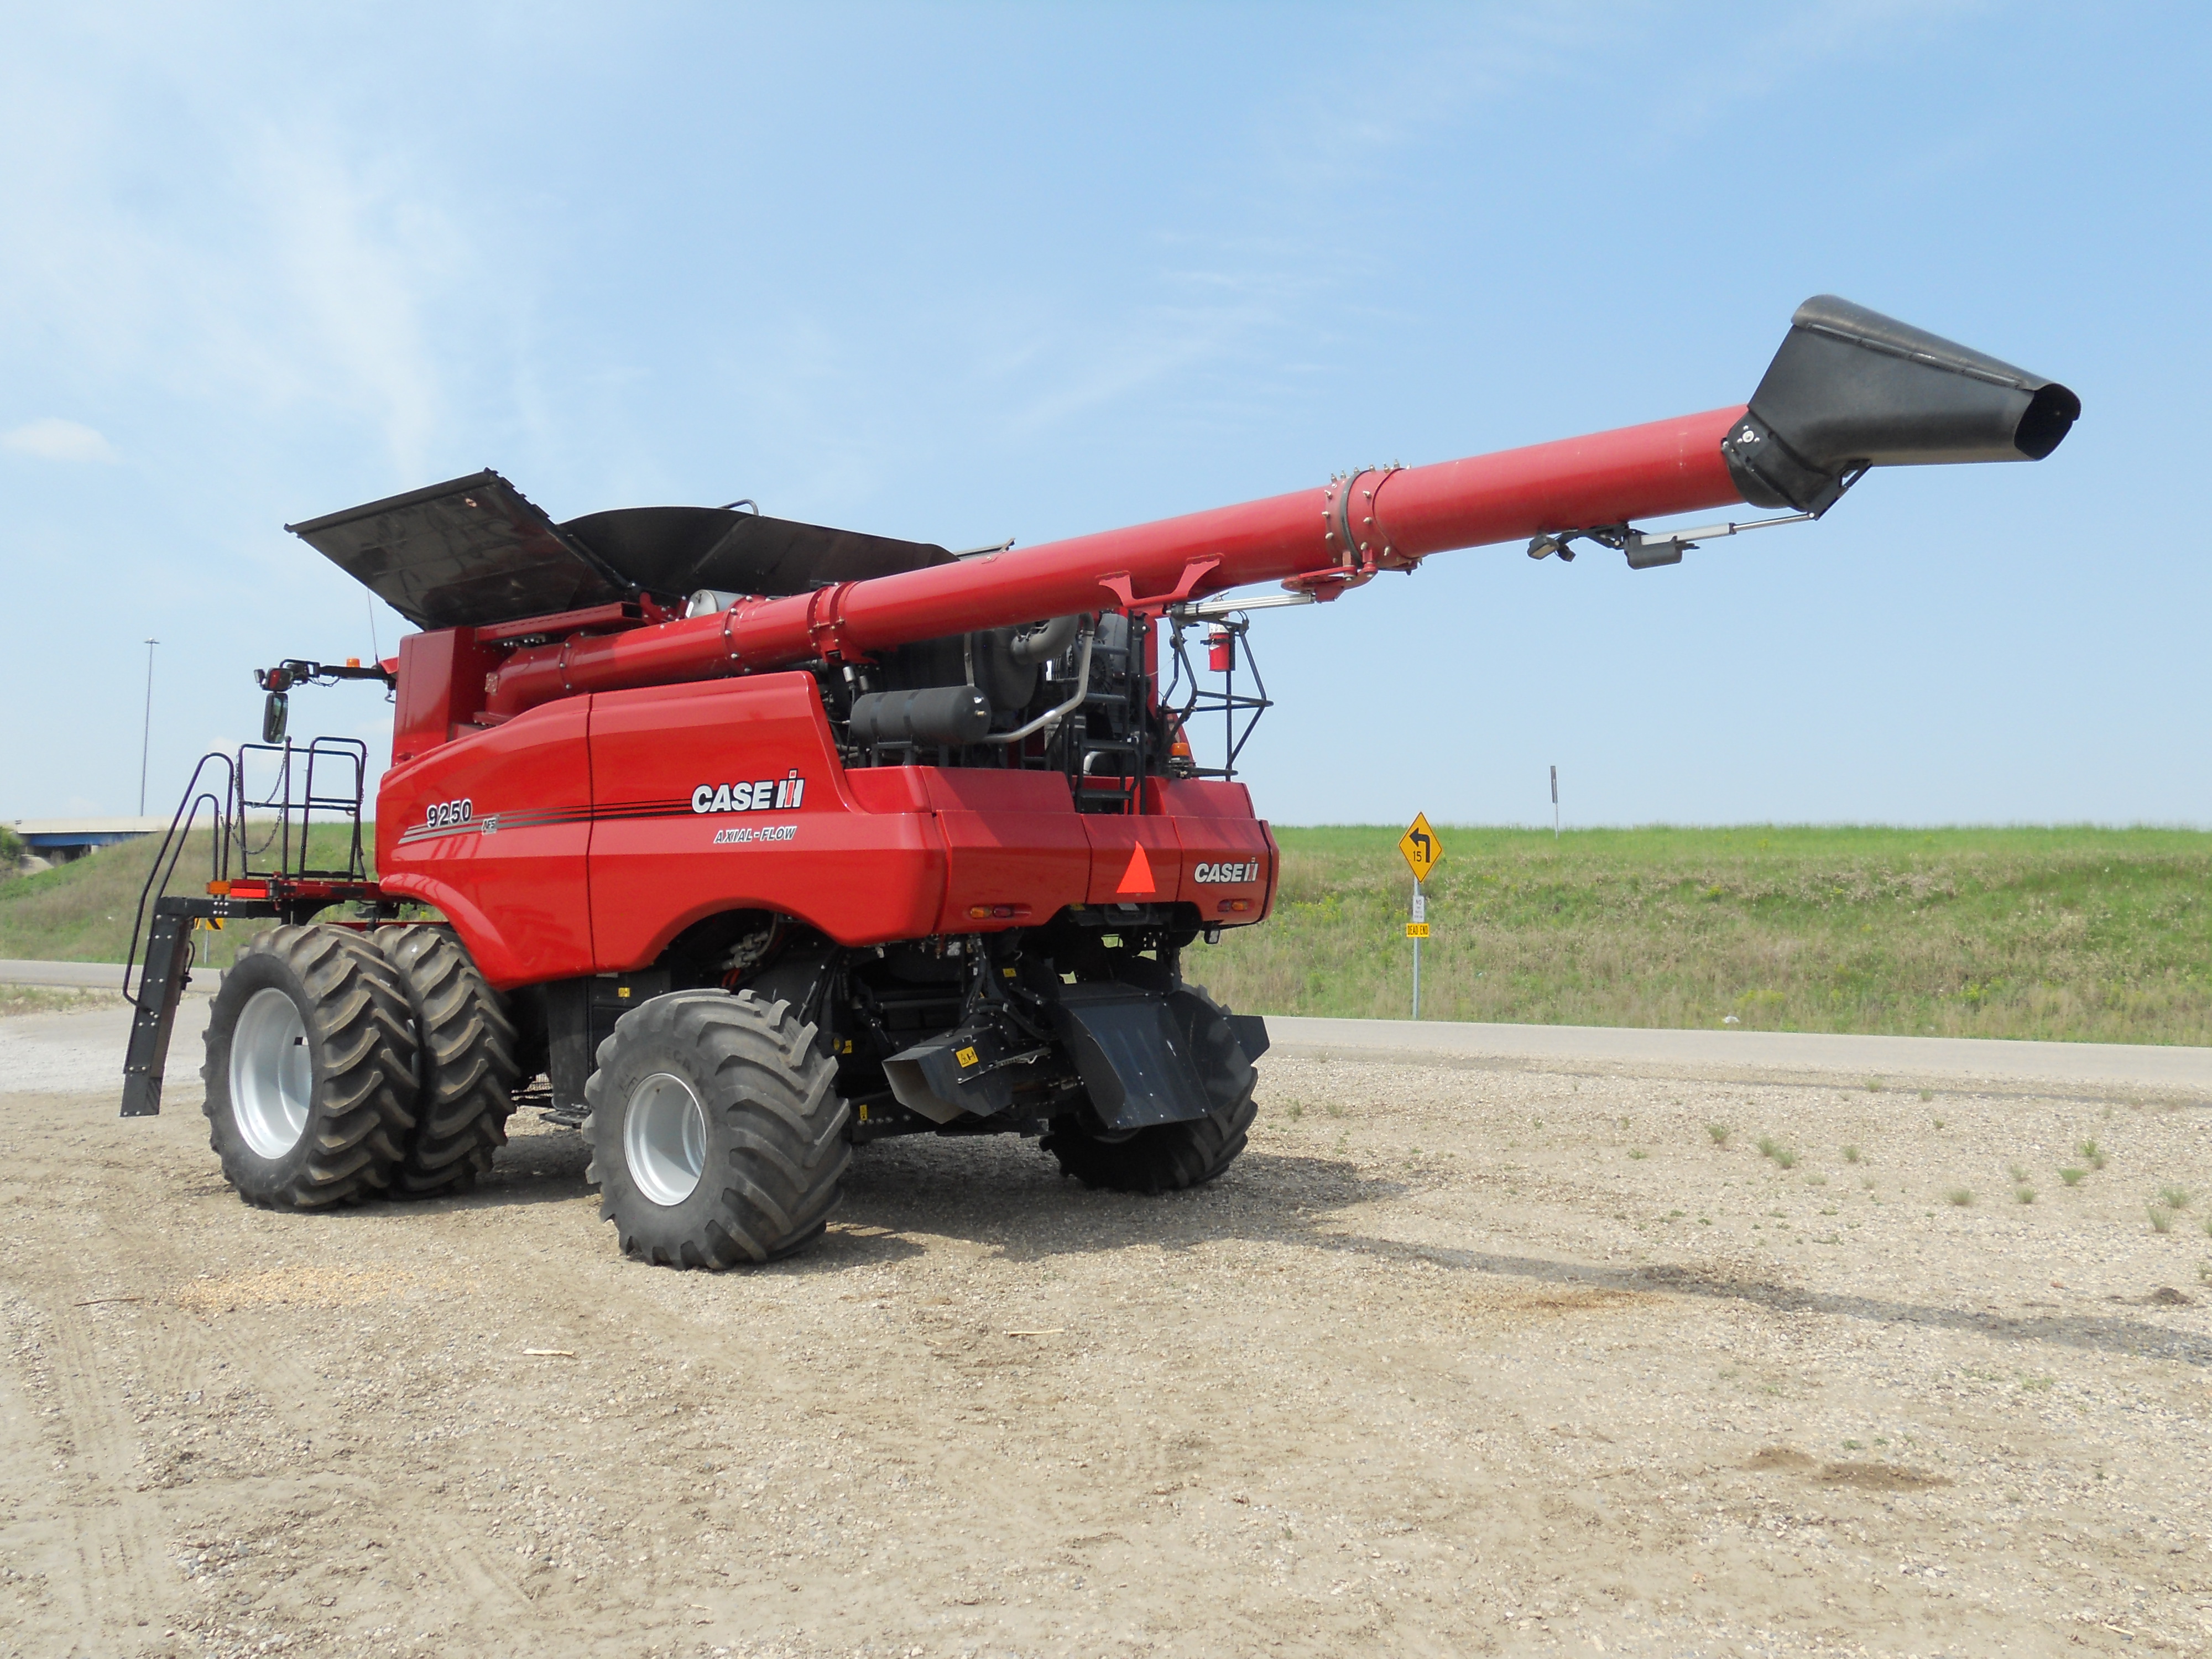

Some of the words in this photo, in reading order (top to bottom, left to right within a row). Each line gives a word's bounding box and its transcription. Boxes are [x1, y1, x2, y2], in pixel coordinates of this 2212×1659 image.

[692, 781, 774, 813] CASE
[427, 799, 472, 827] 9250
[713, 826, 797, 844] AXIAL-FLOW
[1413, 851, 1422, 862] 15
[1194, 863, 1244, 883] CASE
[1407, 925, 1418, 935] DEAD
